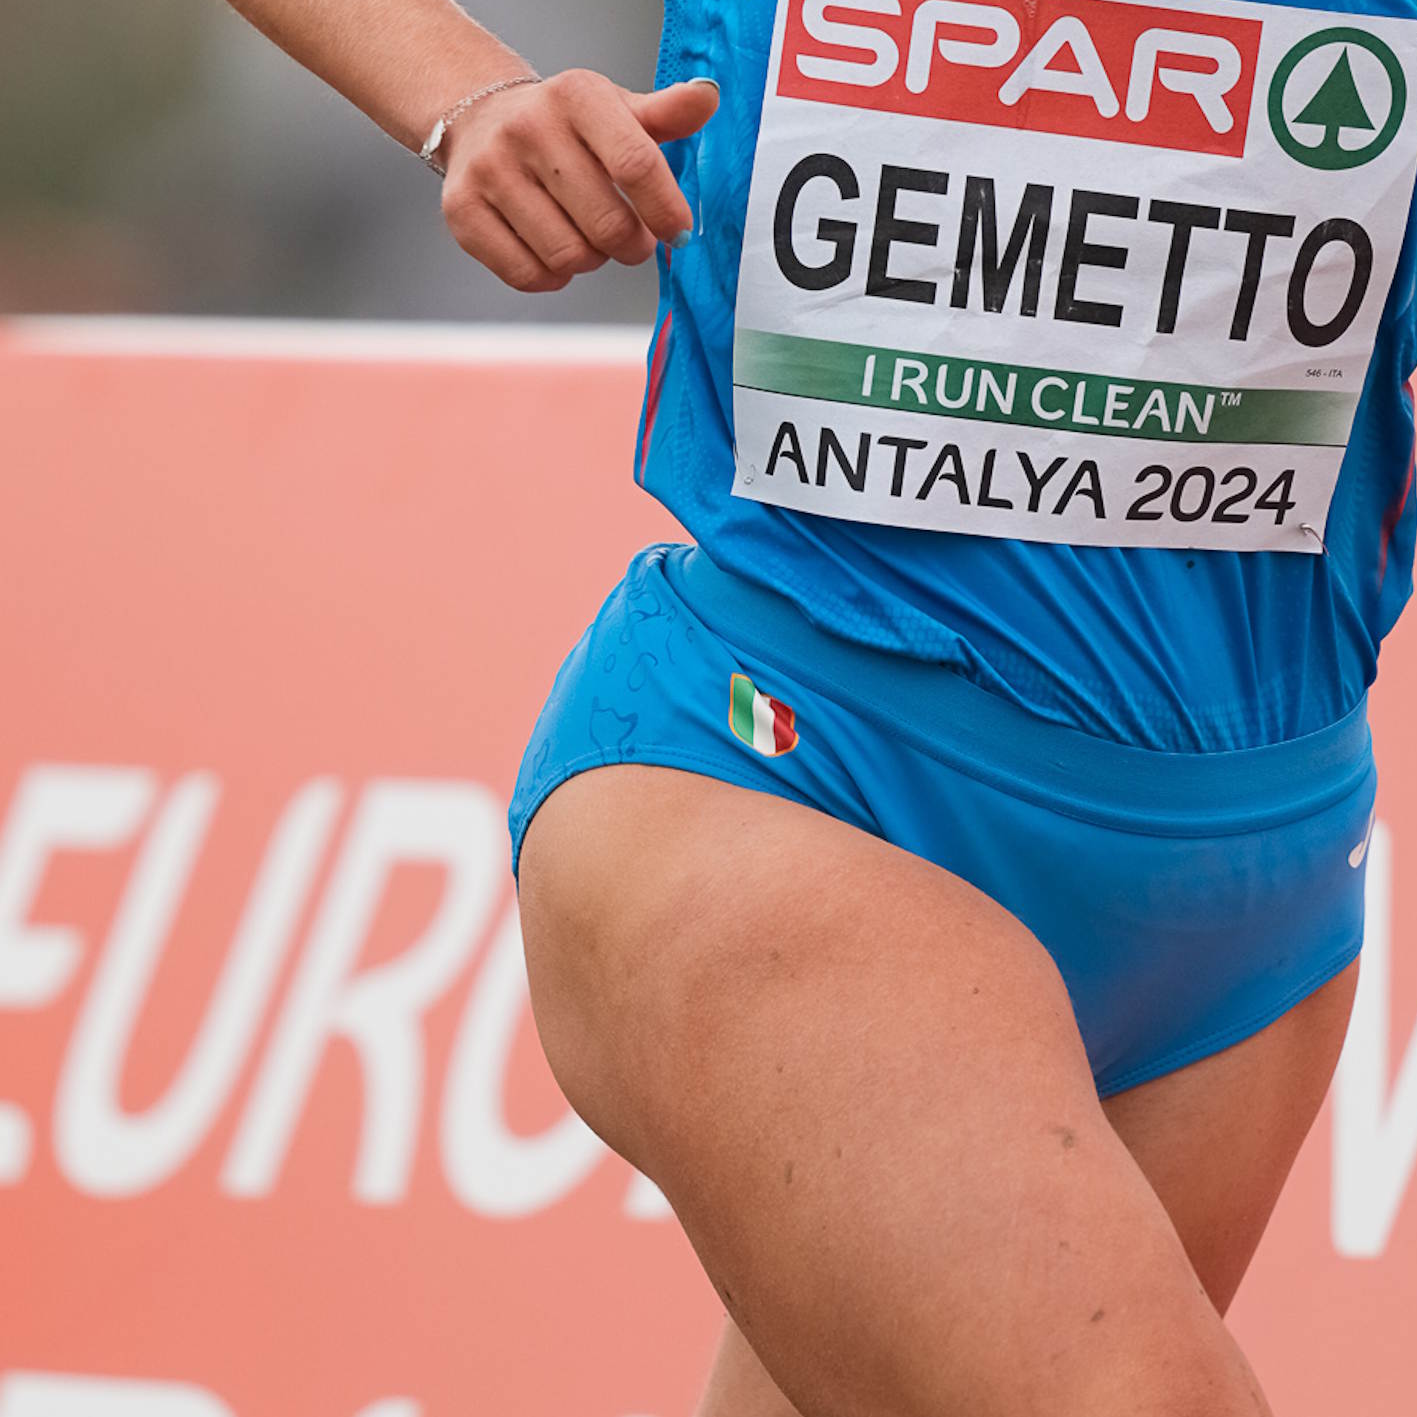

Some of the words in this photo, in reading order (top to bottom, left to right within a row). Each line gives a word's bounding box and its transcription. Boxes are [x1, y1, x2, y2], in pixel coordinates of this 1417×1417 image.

[772, 152, 1374, 348] GEMETTO
[861, 355, 879, 397] I
[891, 359, 1018, 416] RUN
[764, 420, 1108, 519] ANTALYA
[1125, 464, 1296, 526] 2024
